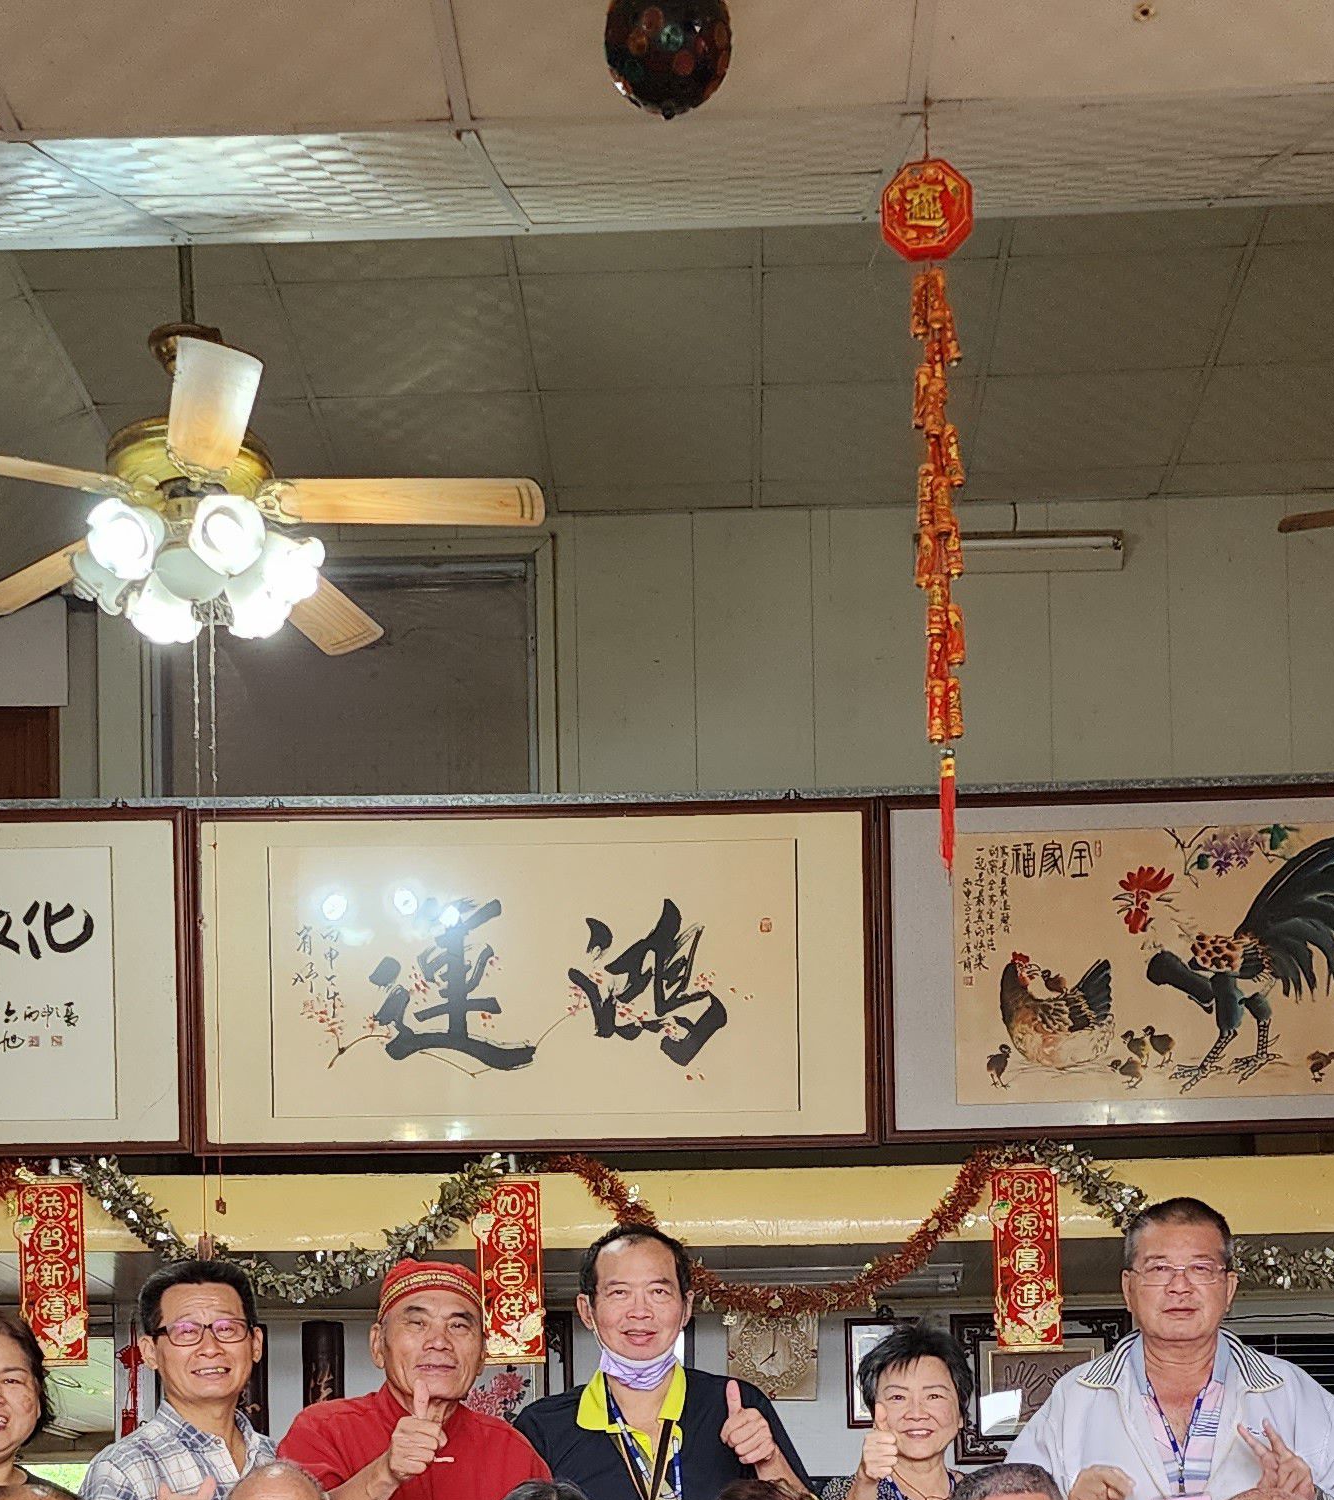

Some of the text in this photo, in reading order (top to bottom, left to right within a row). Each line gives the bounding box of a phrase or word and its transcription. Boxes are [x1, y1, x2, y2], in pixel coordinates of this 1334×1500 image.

[35, 1189, 70, 1325] 恭賀新禧
[493, 1190, 531, 1322] 如意吉祥
[1012, 1176, 1045, 1306] 財源廣進
